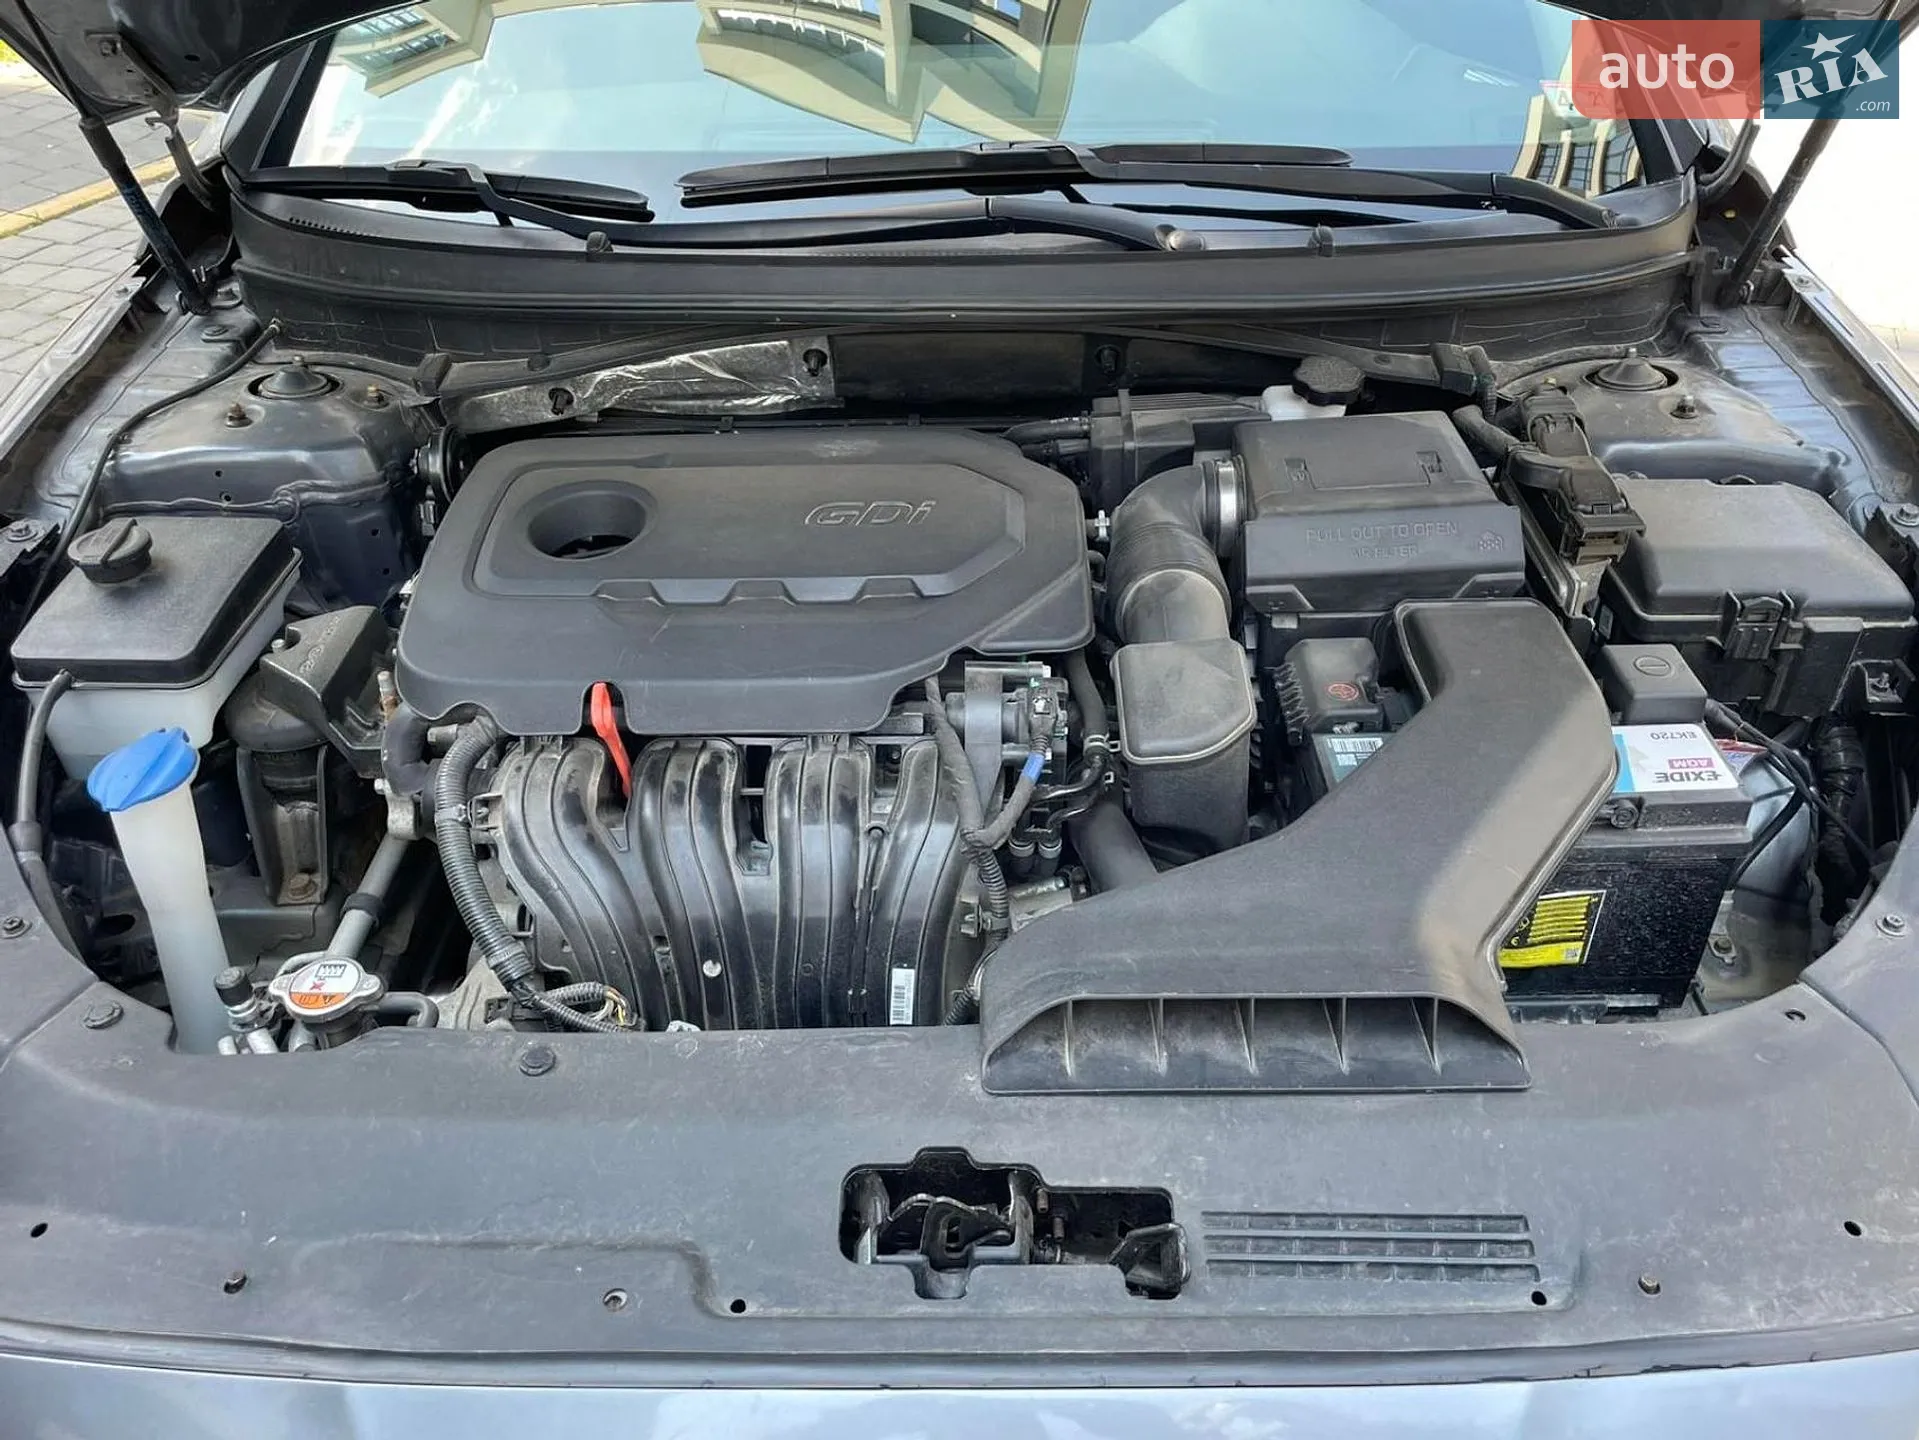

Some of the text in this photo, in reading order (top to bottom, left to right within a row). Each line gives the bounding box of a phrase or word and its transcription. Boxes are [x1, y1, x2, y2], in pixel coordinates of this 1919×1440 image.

[804, 500, 937, 526] GDi
[1351, 525, 1383, 541] OUT
[1391, 523, 1410, 538] TO
[1413, 521, 1459, 537] OPEN
[1650, 730, 1698, 741] EK720
[1654, 770, 1722, 783] EXIDE
